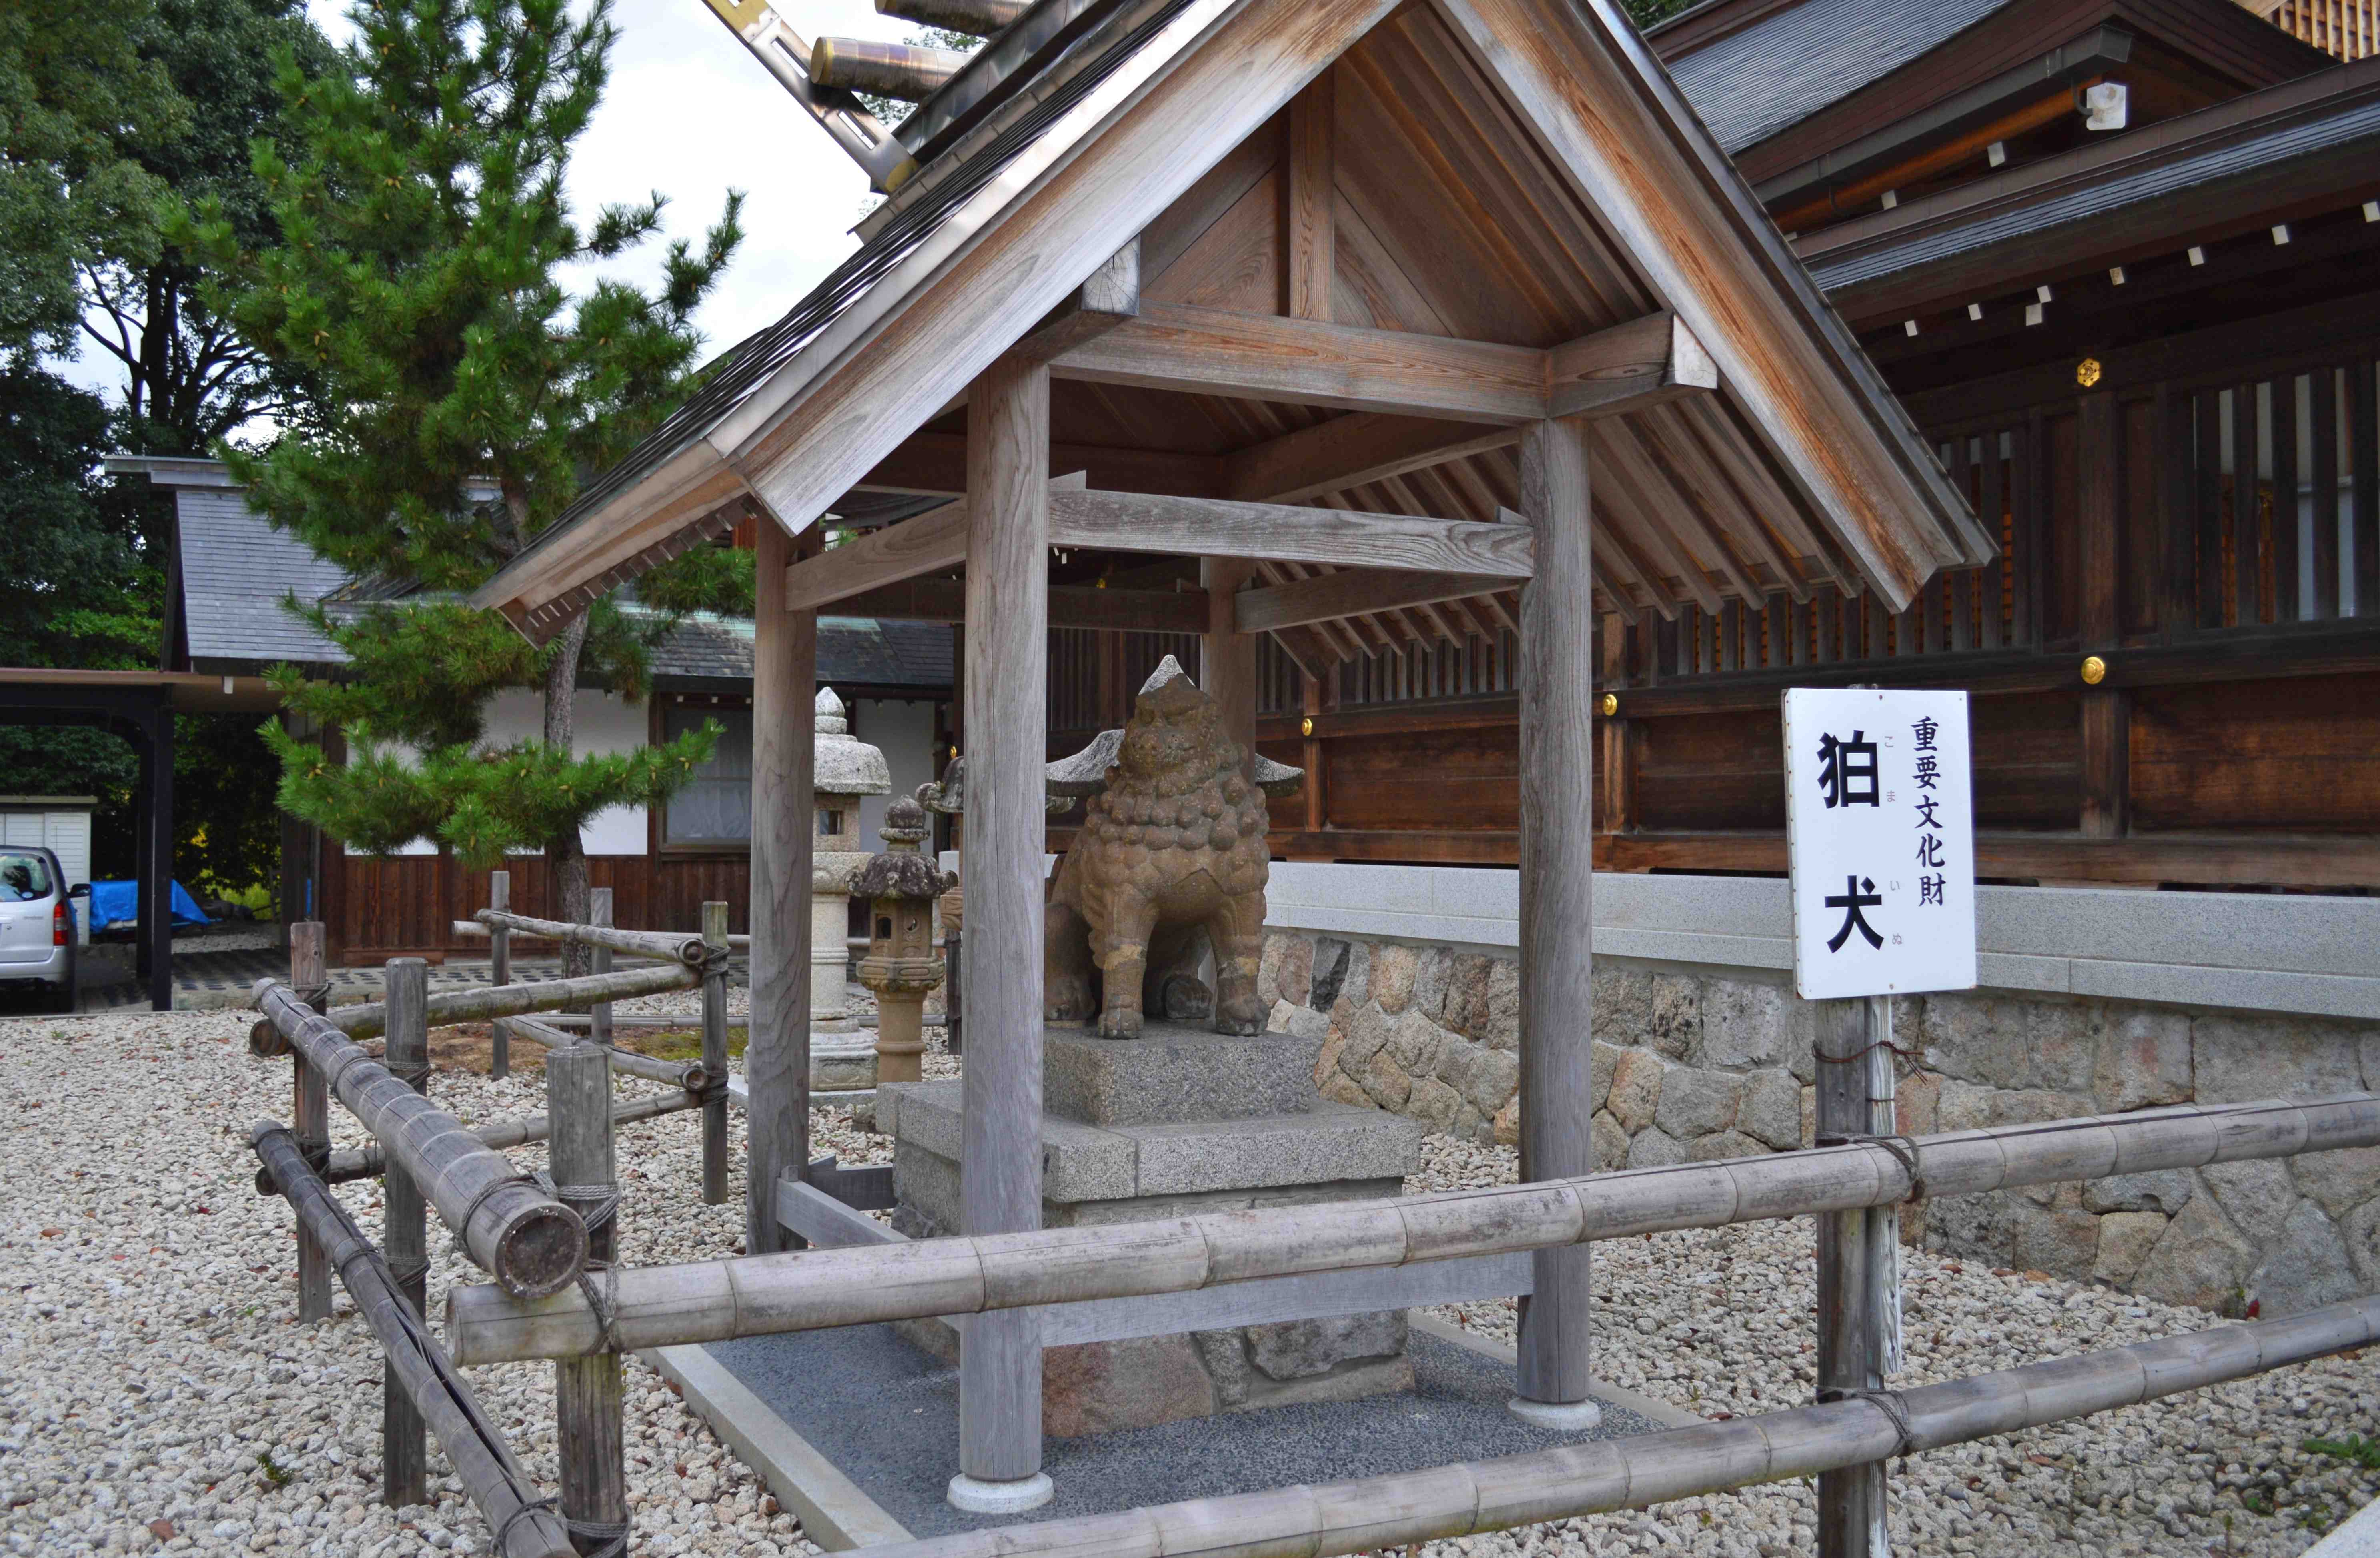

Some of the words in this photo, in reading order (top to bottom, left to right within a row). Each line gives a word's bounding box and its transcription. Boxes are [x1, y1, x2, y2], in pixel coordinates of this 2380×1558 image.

[1816, 729, 1884, 953] 狛犬
[1911, 716, 1947, 907] 重要文化財
